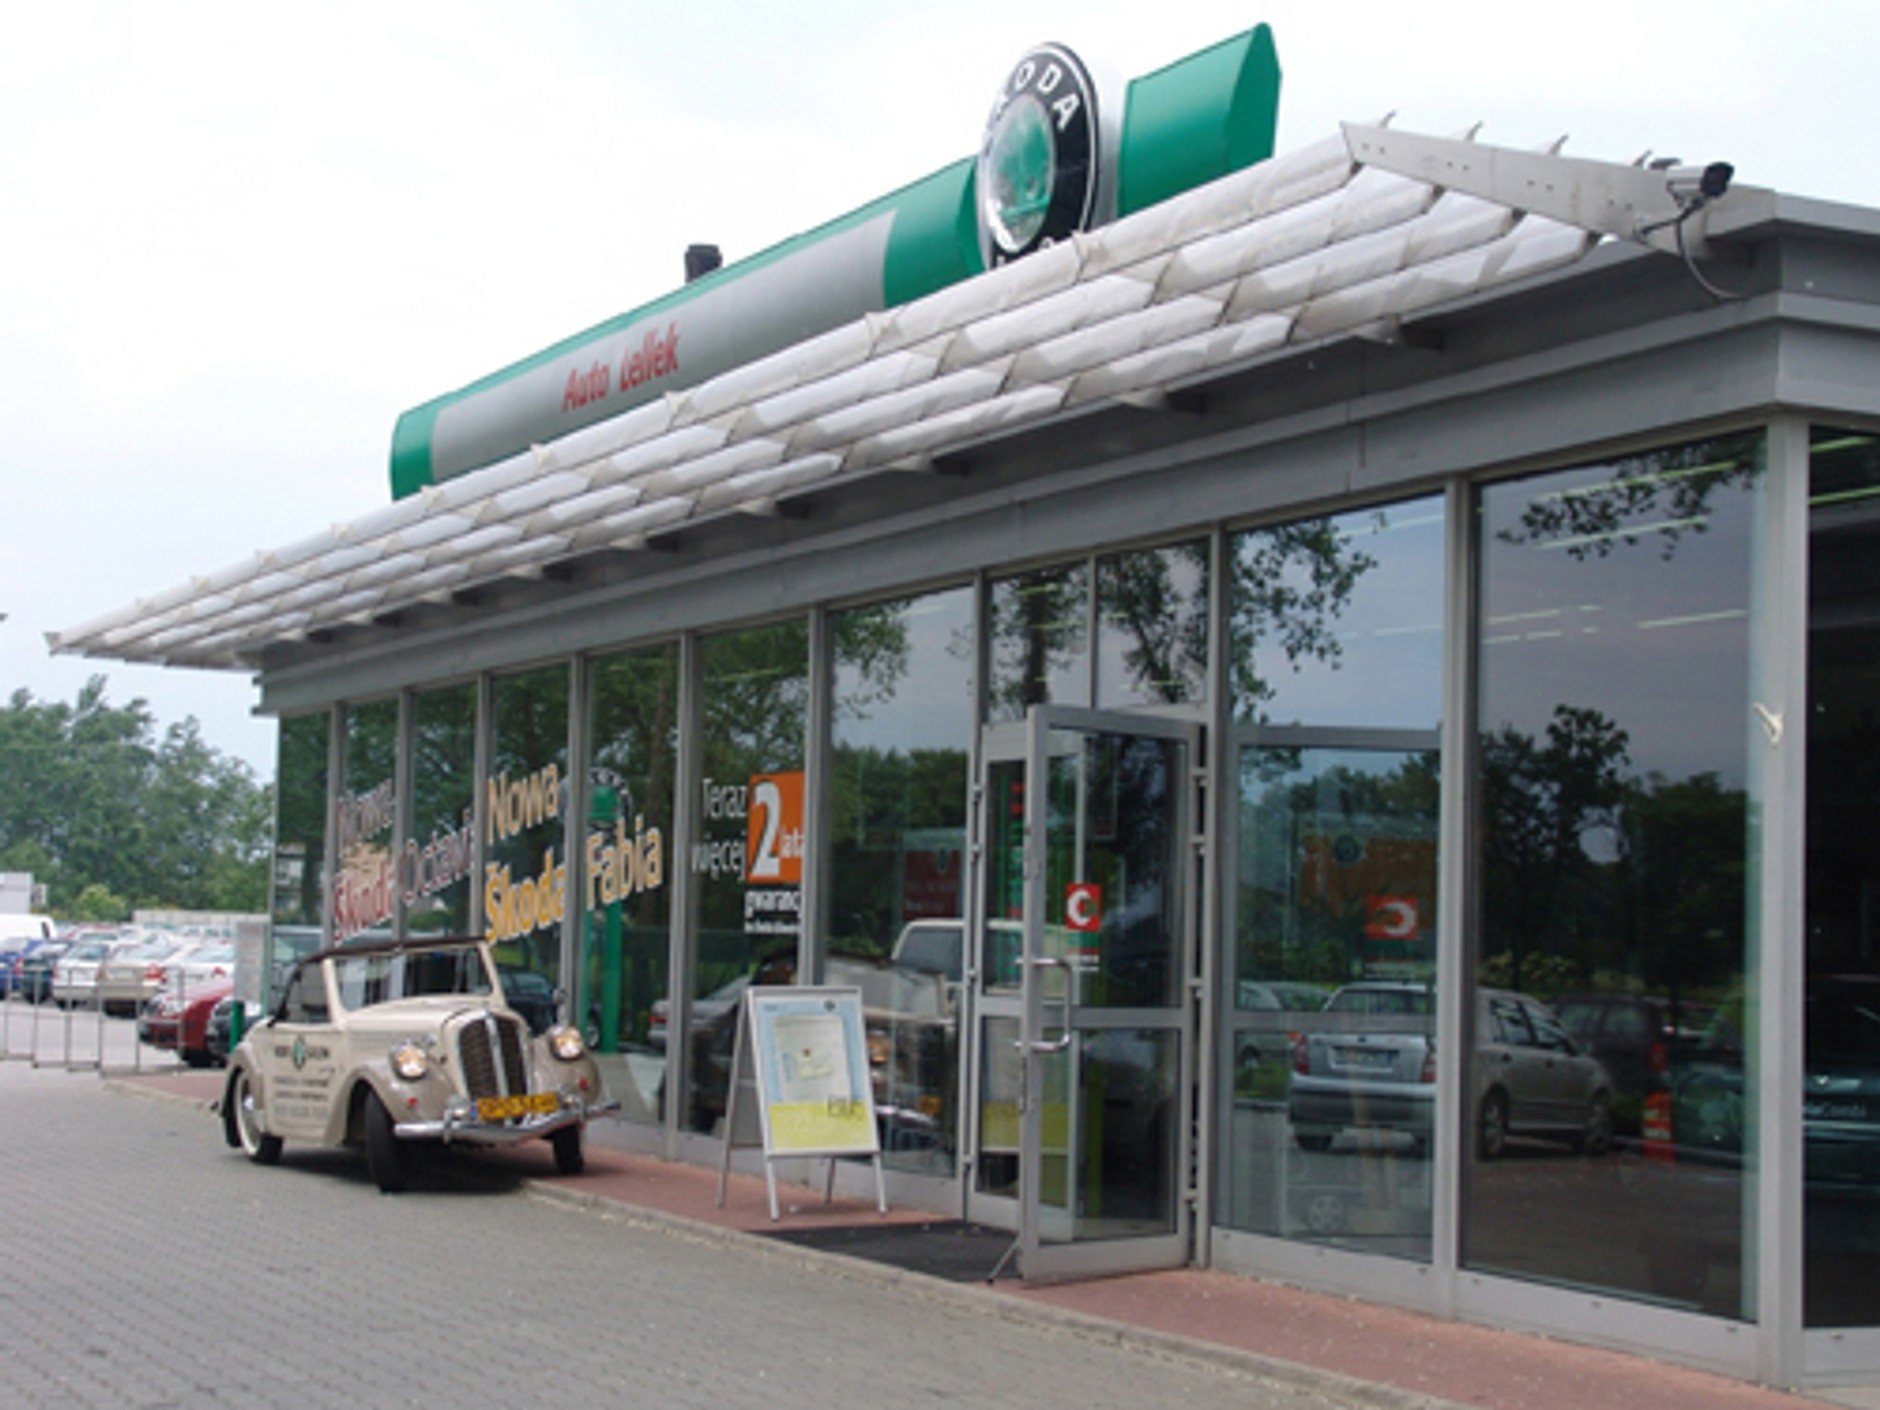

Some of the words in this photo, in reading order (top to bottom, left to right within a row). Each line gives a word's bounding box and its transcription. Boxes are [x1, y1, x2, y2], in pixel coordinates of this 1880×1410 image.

[562, 367, 610, 414] Auto
[487, 763, 557, 846] Nowa
[702, 778, 747, 818] Teraz
[751, 780, 781, 877] 2
[586, 815, 662, 911] Fabia
